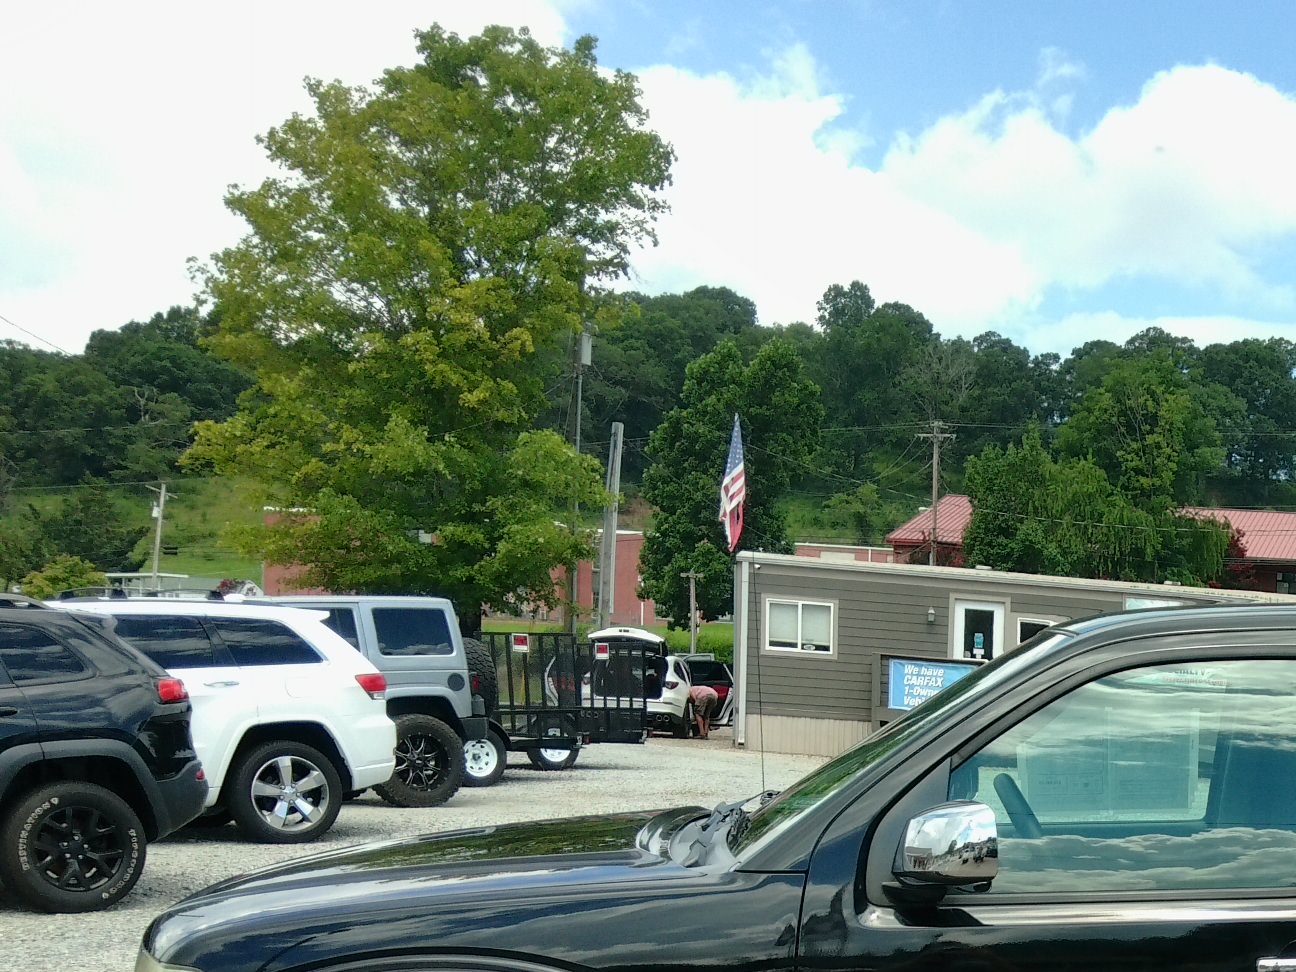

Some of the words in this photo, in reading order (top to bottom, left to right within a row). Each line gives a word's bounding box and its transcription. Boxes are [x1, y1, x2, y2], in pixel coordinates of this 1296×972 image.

[904, 664, 919, 675] We
[920, 666, 944, 677] have
[904, 674, 944, 687] CARFAX
